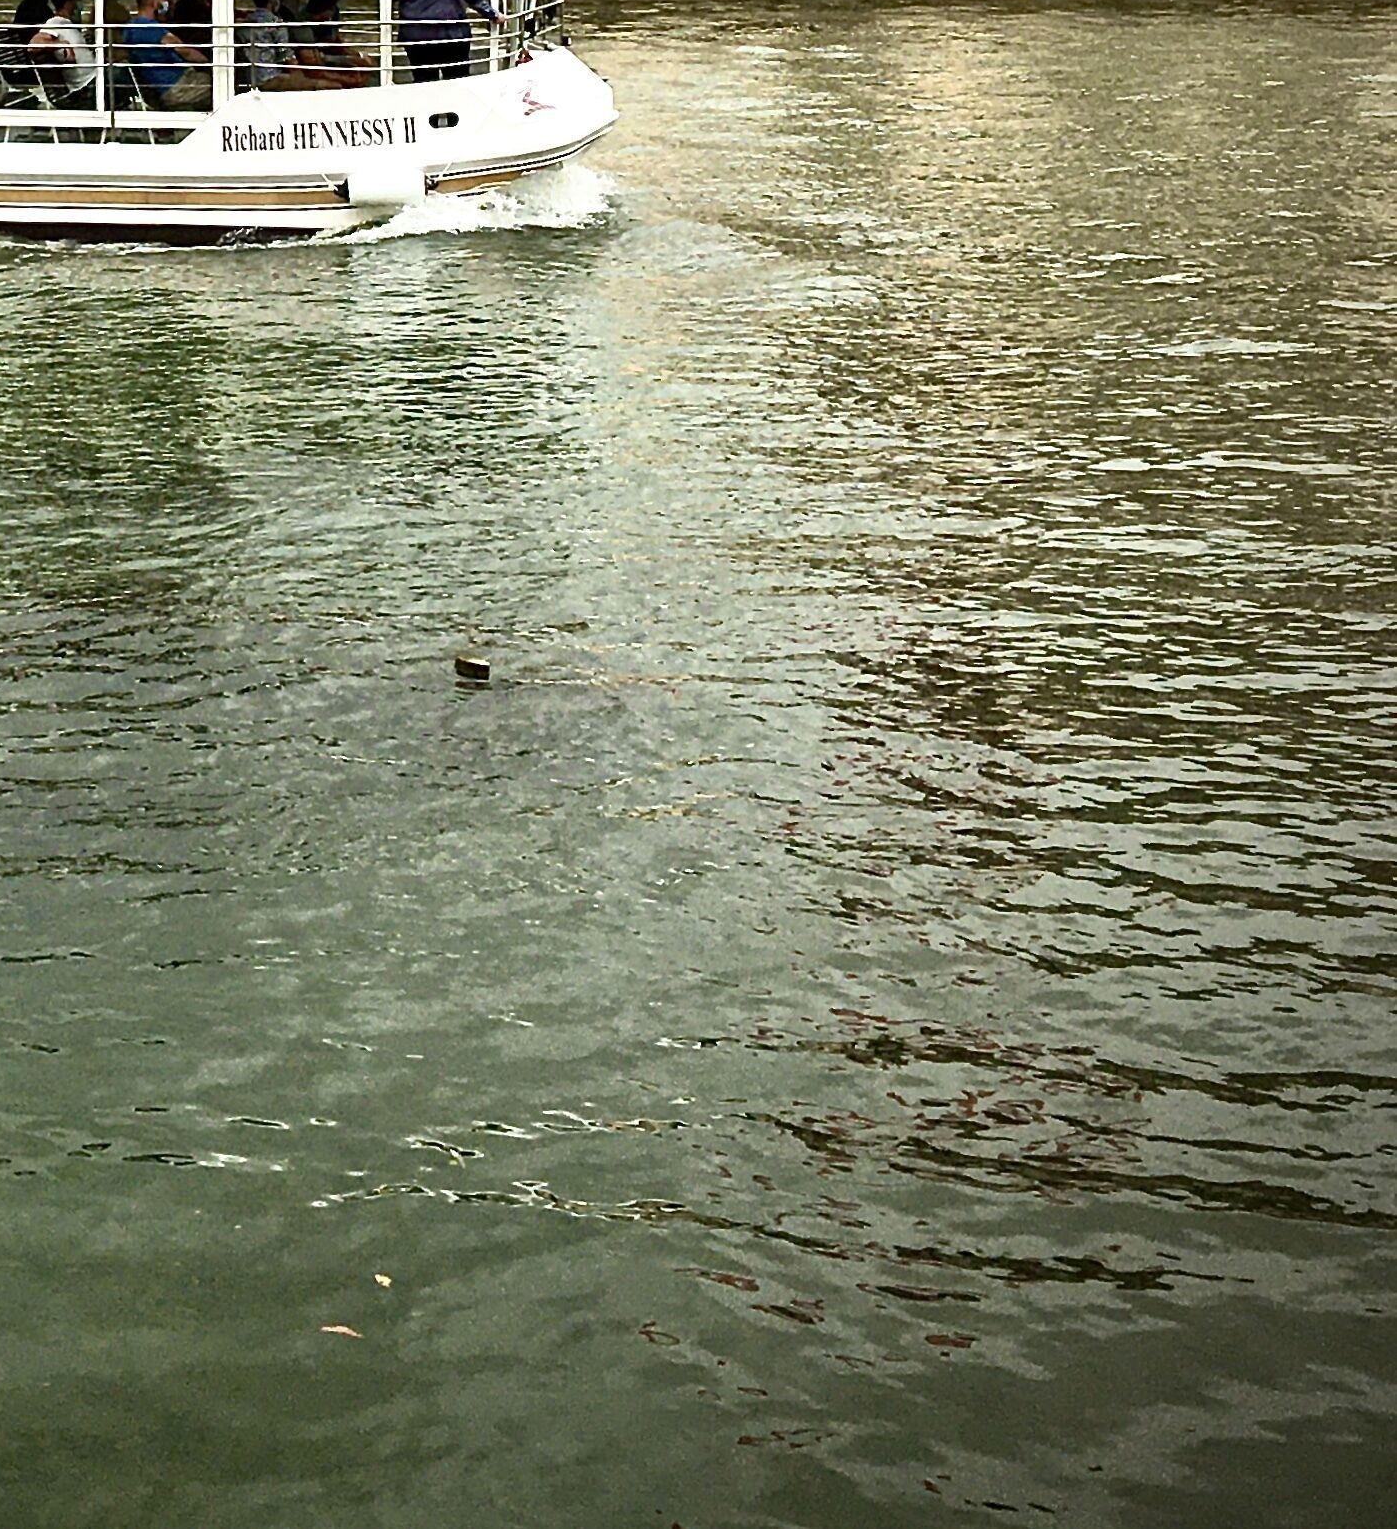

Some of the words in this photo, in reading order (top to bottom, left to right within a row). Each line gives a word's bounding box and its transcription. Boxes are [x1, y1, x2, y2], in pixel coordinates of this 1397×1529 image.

[221, 123, 286, 152] Richard
[292, 117, 396, 150] HENNESSY
[403, 116, 417, 144] II
